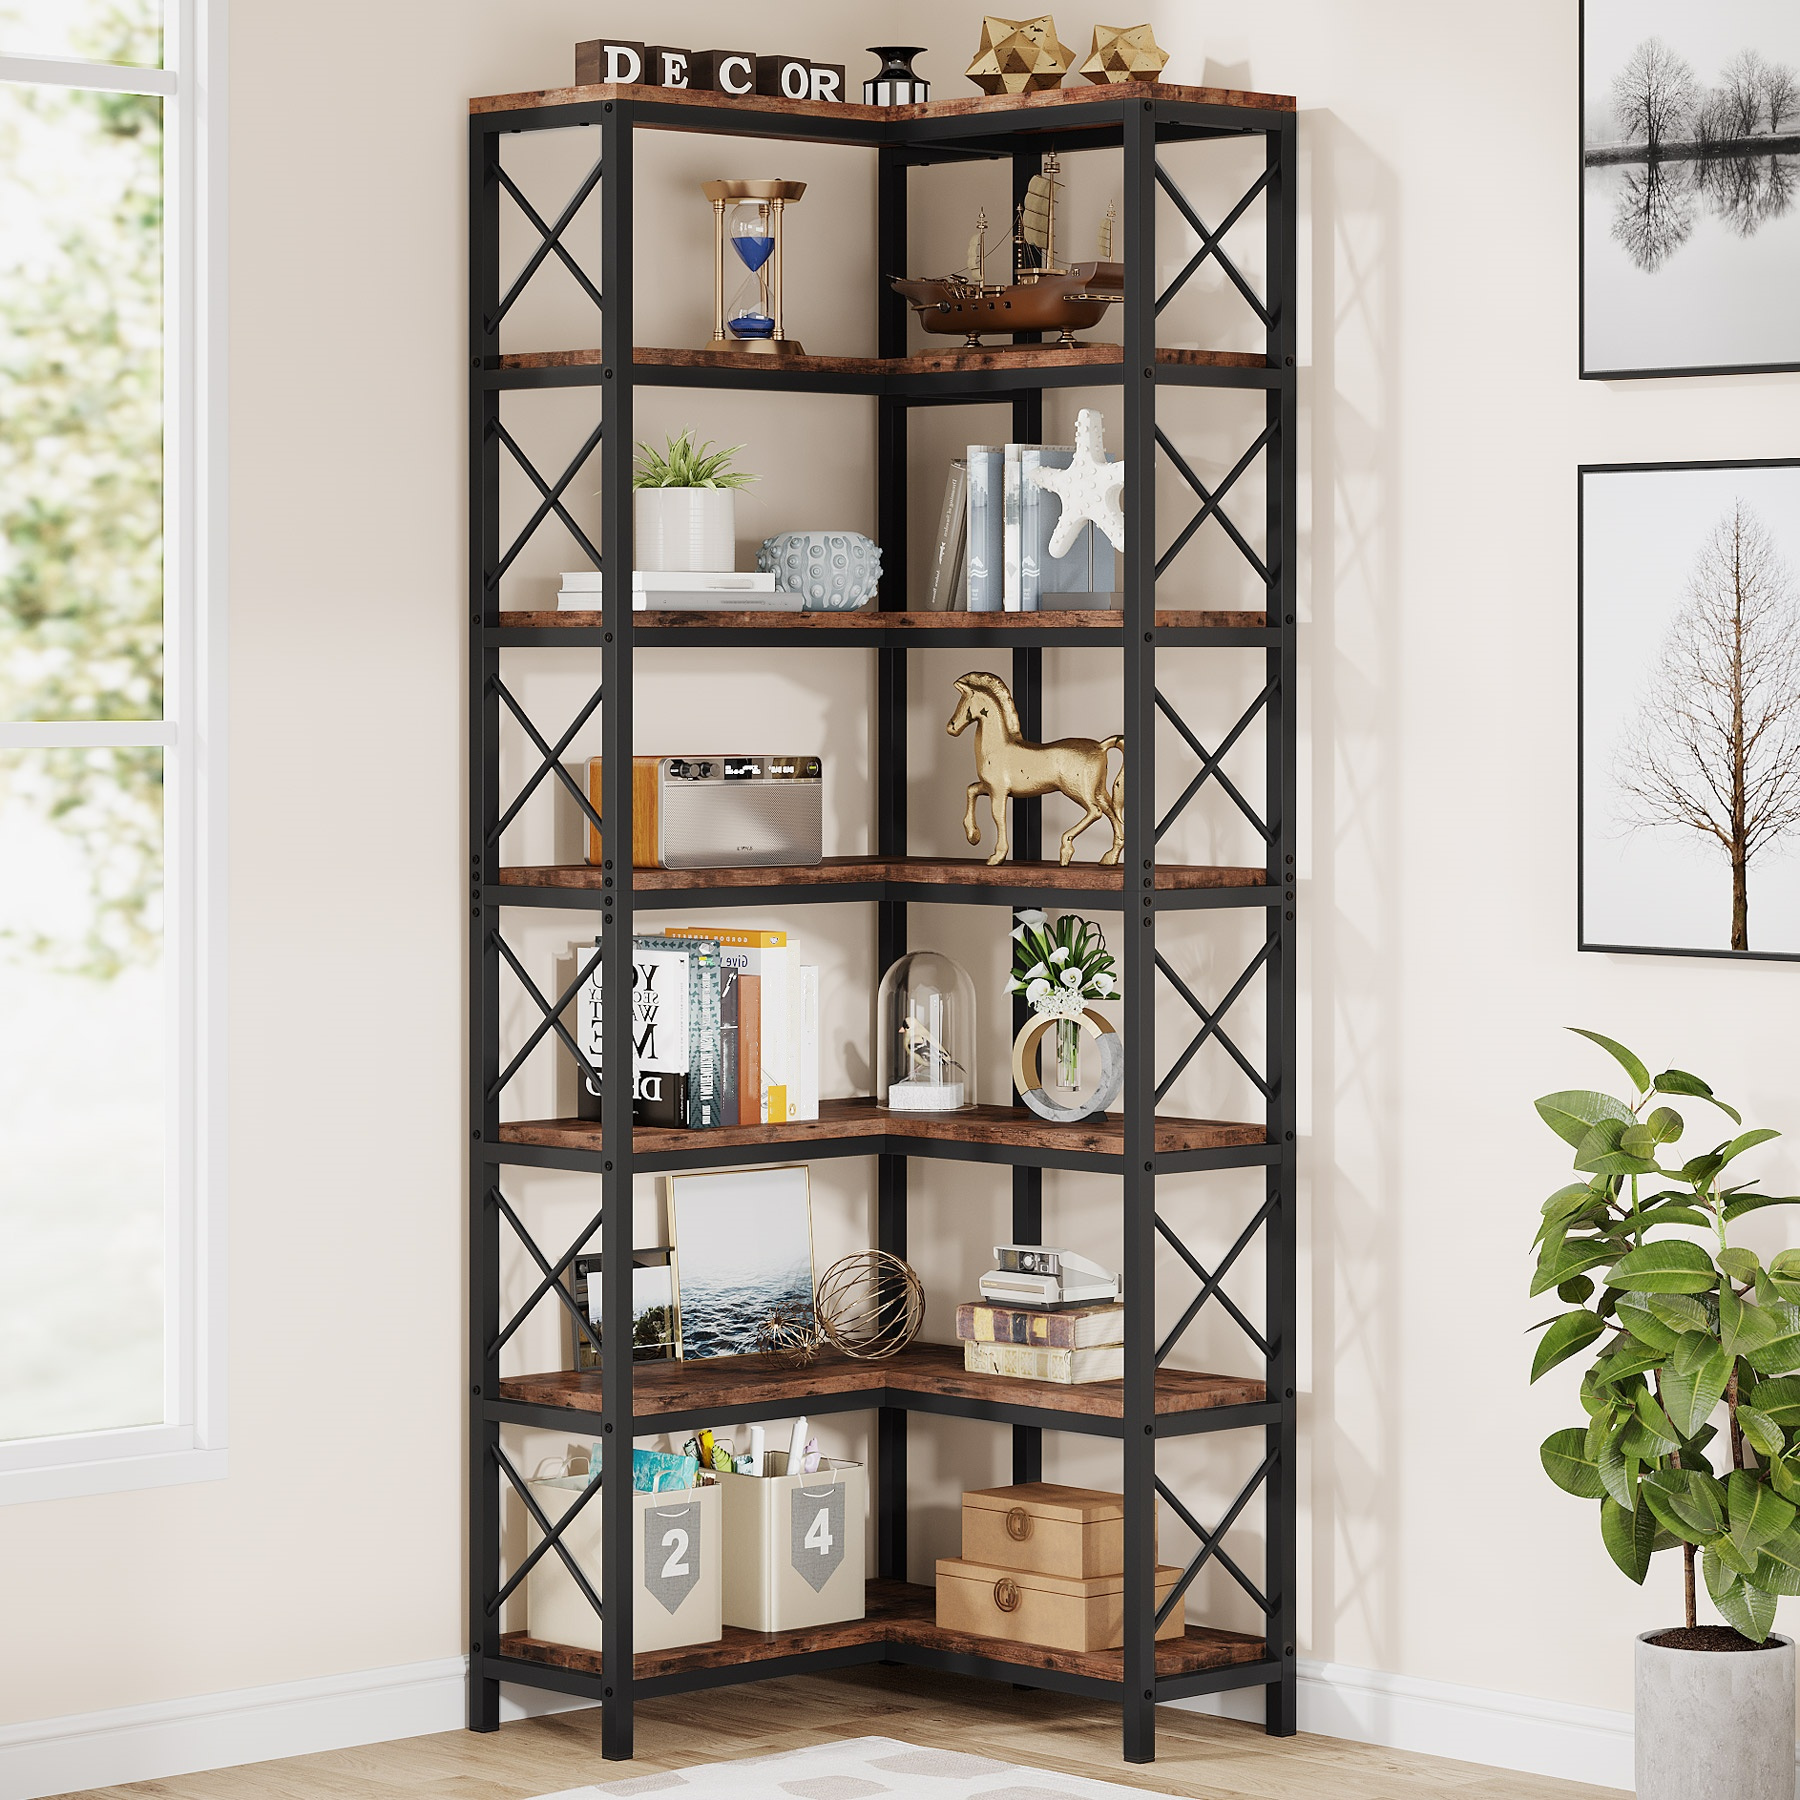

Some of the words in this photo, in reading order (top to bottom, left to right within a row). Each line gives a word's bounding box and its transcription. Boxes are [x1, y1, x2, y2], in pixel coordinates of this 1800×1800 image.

[603, 45, 842, 103] DECOR
[660, 1528, 690, 1578] 2
[804, 1507, 833, 1556] 4
